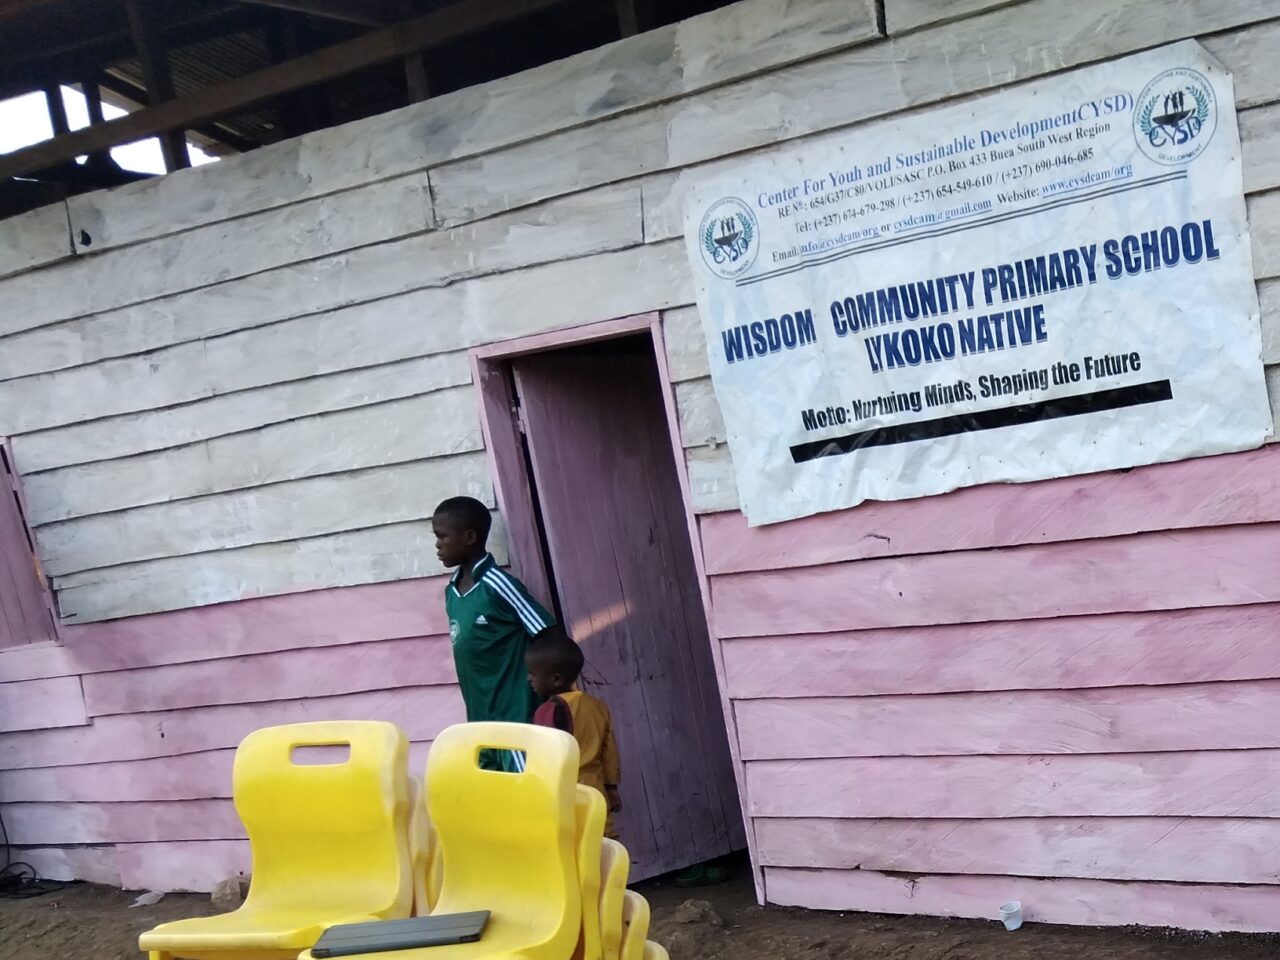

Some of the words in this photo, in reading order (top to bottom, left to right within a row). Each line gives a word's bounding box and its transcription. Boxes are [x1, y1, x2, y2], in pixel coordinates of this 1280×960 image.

[758, 187, 799, 209] Center
[803, 177, 826, 195] For
[867, 157, 891, 178] and
[896, 135, 976, 168] Sustainable
[949, 158, 967, 171] Box
[969, 153, 987, 165] 433
[991, 148, 1014, 162] Buea
[1017, 139, 1045, 155] South
[1049, 131, 1073, 145] West
[1076, 122, 1111, 141] Region
[881, 224, 891, 232] or
[997, 188, 1040, 205] Website:
[1042, 164, 1133, 197] www.cysdcam/org
[902, 189, 935, 208] (+237)
[936, 173, 993, 197] 654-549-610
[1001, 164, 1033, 184] (+237)
[1035, 148, 1094, 172] 690-046-685
[721, 308, 817, 364] WISDOM
[830, 271, 975, 338] COMMUNITY
[982, 244, 1098, 306] PRIMARY
[1103, 219, 1220, 280] SCHOOL
[958, 304, 1048, 357] NATIVE
[924, 379, 977, 408] Minds,
[978, 366, 1049, 398] Shaping
[1051, 361, 1081, 386] the
[1084, 351, 1142, 381] Future
